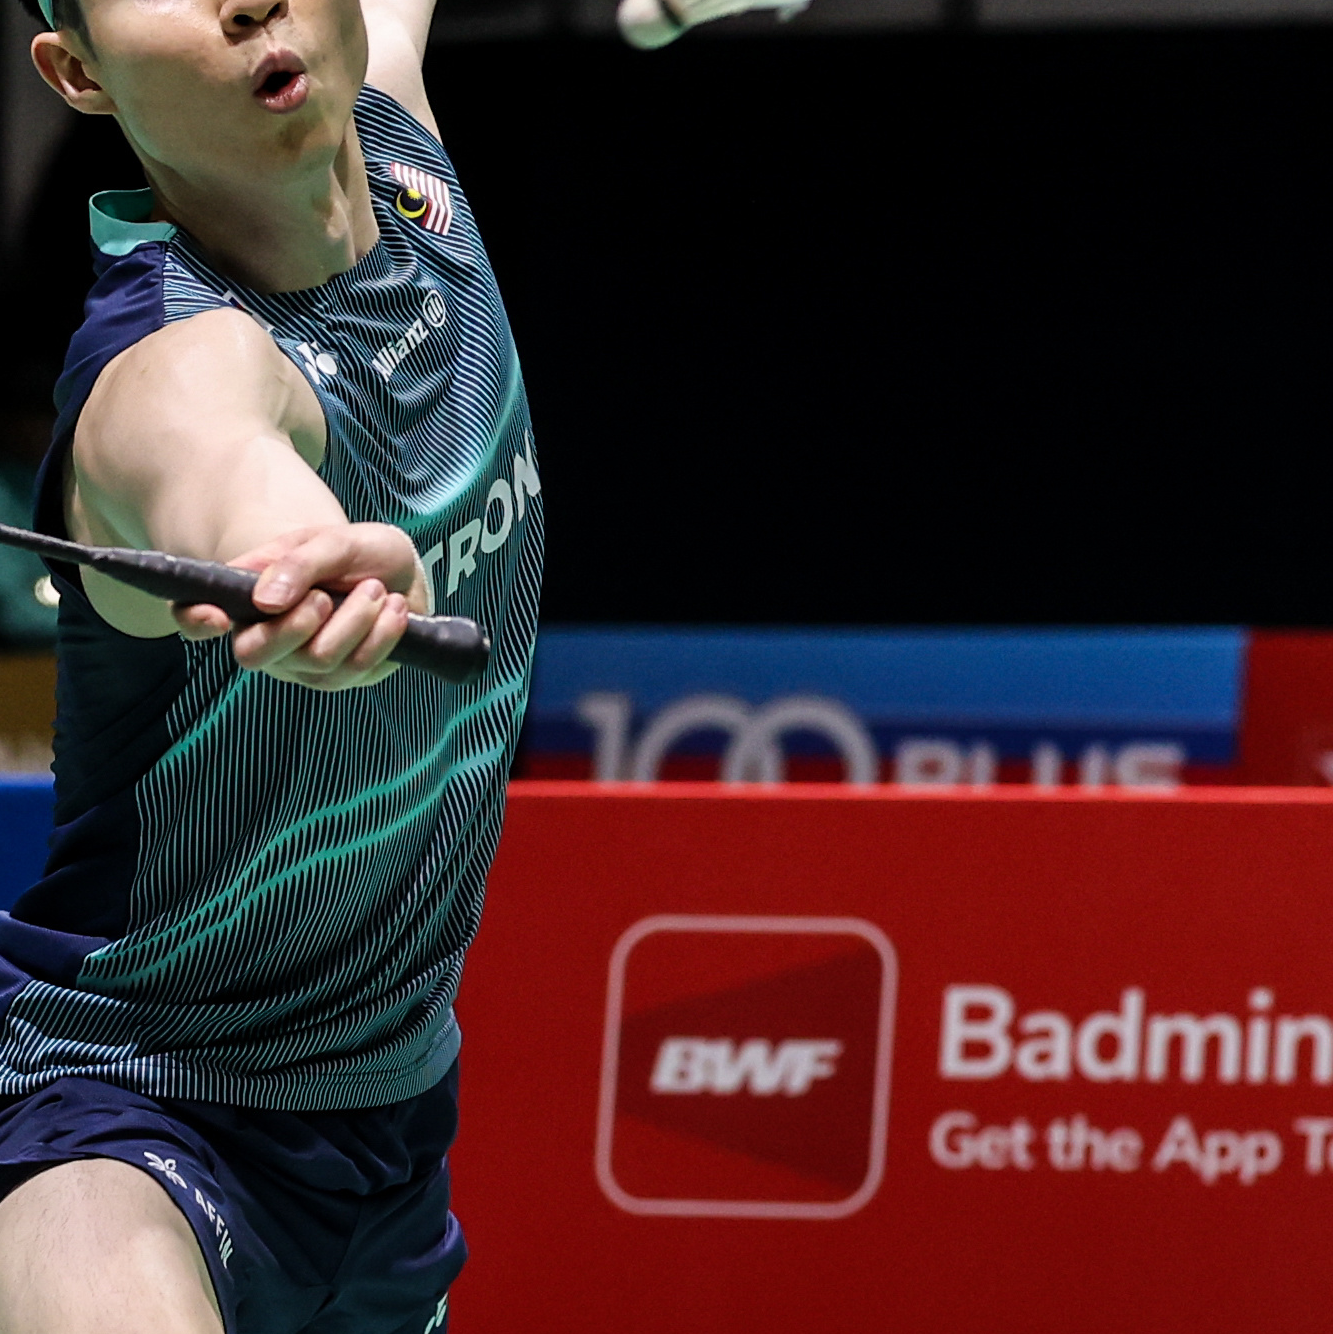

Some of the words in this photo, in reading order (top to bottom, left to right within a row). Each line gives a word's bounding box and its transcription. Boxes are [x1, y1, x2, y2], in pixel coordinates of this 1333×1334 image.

[372, 317, 430, 383] Allianz
[651, 1037, 842, 1096] BWF
[938, 984, 1333, 1085] Badmin
[930, 1111, 1034, 1169] Get
[1046, 1114, 1143, 1172] the
[1153, 1117, 1282, 1185] App
[1294, 1117, 1333, 1174] T
